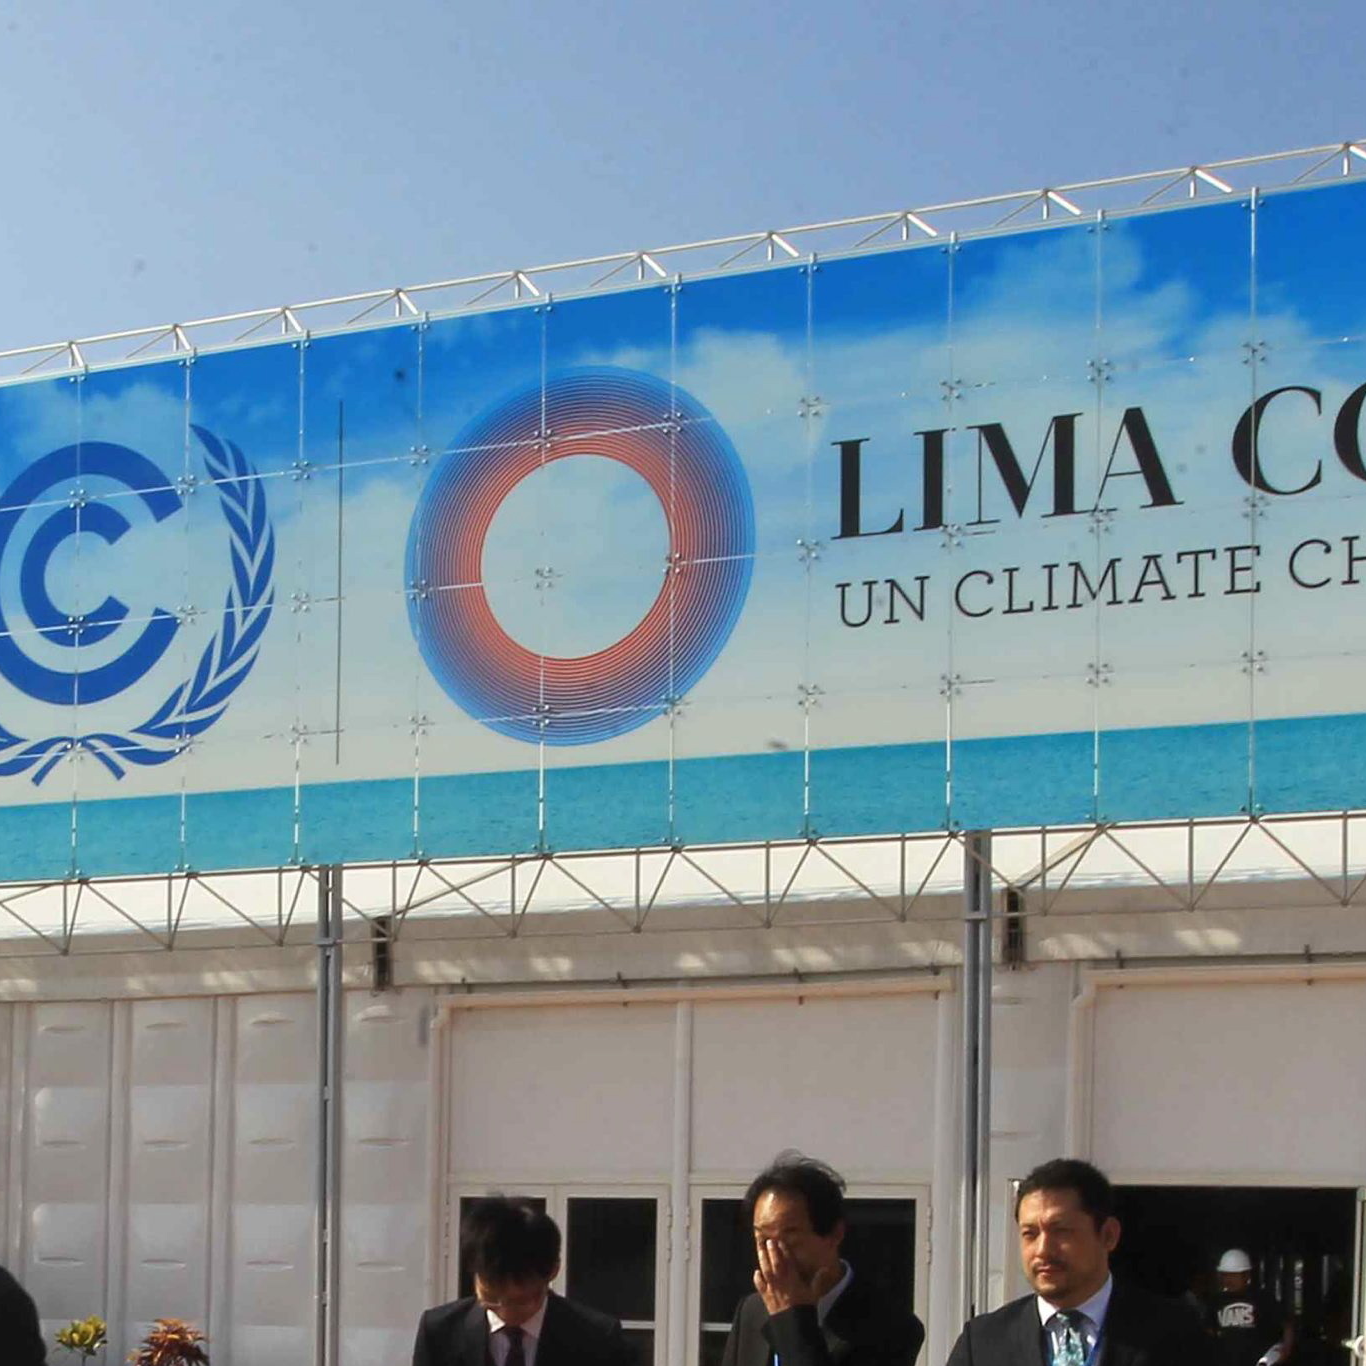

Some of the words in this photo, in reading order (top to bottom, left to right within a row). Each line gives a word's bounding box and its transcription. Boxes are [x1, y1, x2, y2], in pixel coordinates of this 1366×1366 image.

[830, 405, 1186, 541] LIMA
[836, 575, 931, 628] UN
[954, 544, 1263, 619] CLIMATE
